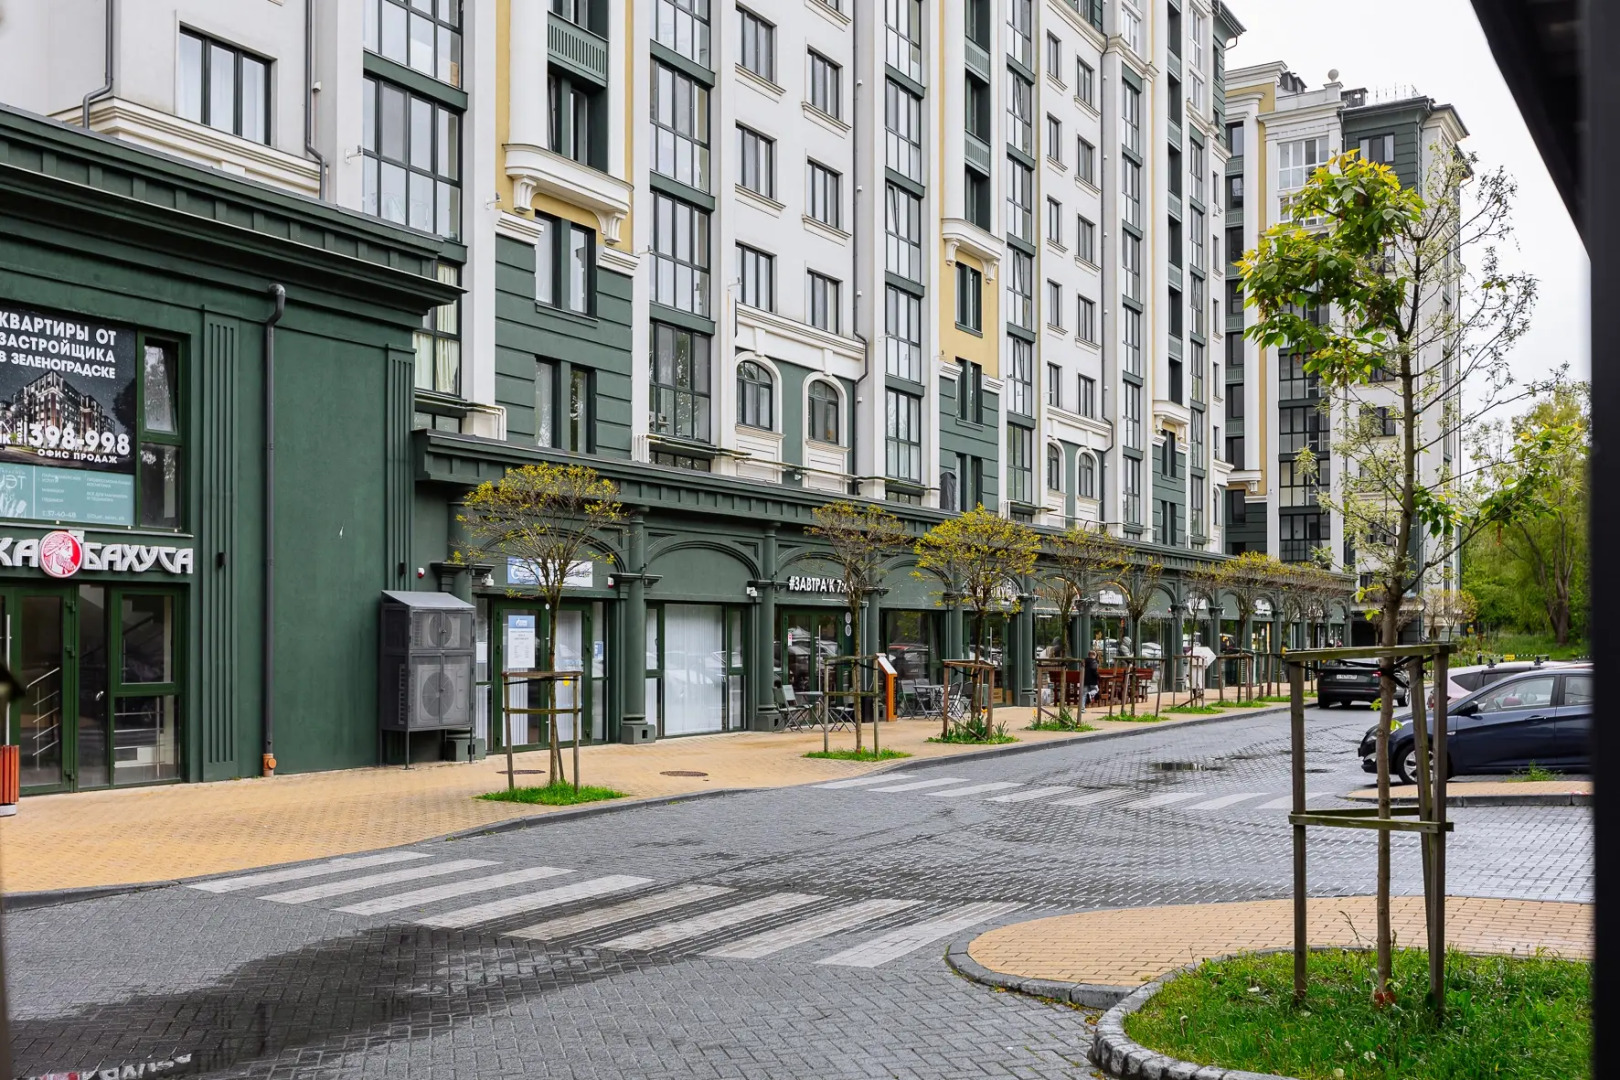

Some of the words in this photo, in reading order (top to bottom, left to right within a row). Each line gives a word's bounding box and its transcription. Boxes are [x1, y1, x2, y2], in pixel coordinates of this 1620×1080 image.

[0, 311, 89, 342] КВАРТИРЫ
[96, 328, 117, 346] ОТ
[0, 331, 116, 364] ЗАСТРОЙЩИКА
[11, 352, 116, 379] ЗЕЛЕНОГРАДСКЕ
[28, 423, 131, 456] 398-998
[37, 448, 70, 459] ОФИС
[73, 452, 118, 464] ПРОДАЖ
[82, 542, 194, 574] БАХУСА
